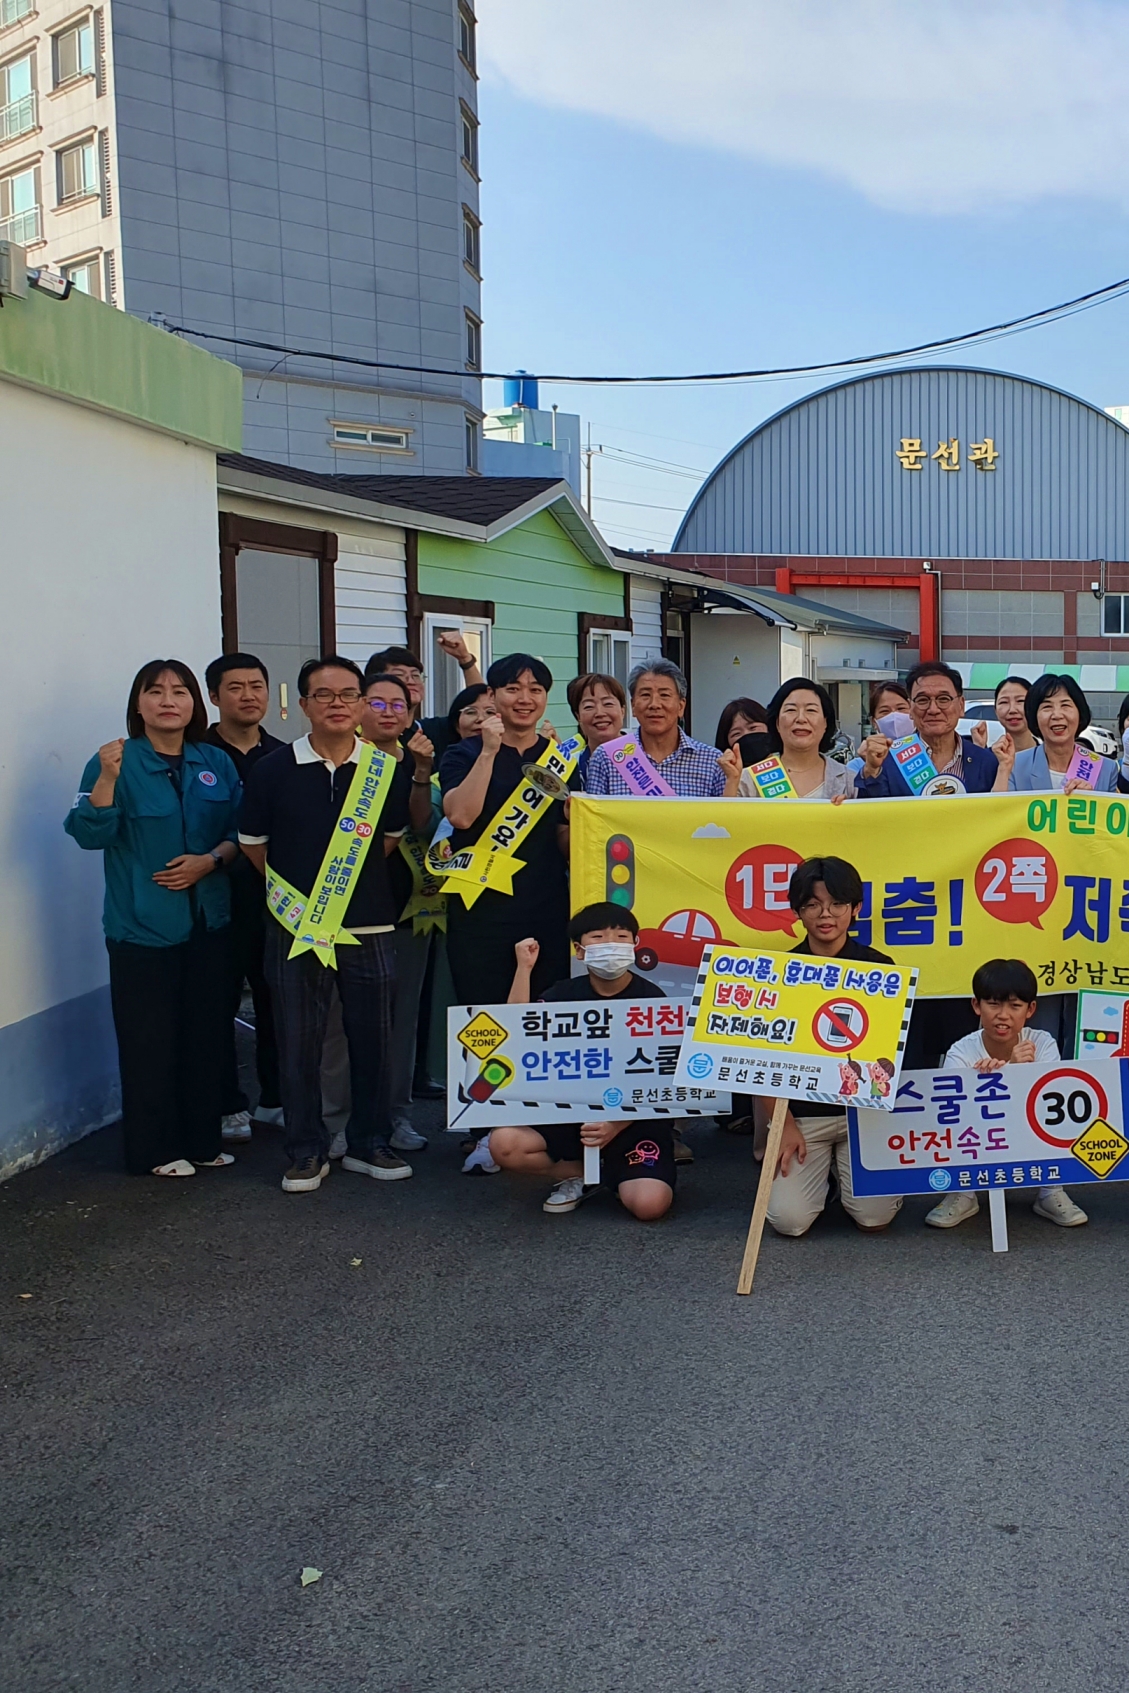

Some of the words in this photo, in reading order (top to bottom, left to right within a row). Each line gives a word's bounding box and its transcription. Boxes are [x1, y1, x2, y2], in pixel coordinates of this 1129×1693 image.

[895, 437, 999, 470] 문선관
[354, 777, 381, 819] 안전속도
[340, 820, 355, 831] 50
[357, 824, 371, 836] 30
[325, 856, 344, 885] 사람이
[334, 865, 351, 896] 줄이면
[309, 885, 332, 925] 보입니다
[851, 876, 964, 947] 춤!
[982, 857, 1048, 903] 2쪽
[713, 956, 778, 983] 이어폰,
[784, 960, 841, 989] 휴대폰
[845, 969, 901, 995] 사용은
[716, 983, 753, 1008] 보행
[757, 988, 778, 1009] 시
[465, 1027, 502, 1039] SCHOOL
[521, 1008, 614, 1042] 학교앞
[625, 1004, 690, 1038] 천천
[708, 1013, 797, 1044] 자제해요!
[471, 1038, 497, 1048] ZONE
[521, 1047, 614, 1082] 안전한
[624, 1045, 682, 1077] 스쿨
[718, 1066, 819, 1091] 문선초등학교
[631, 1087, 717, 1104] 문선초등학교
[889, 1072, 1012, 1125] 스쿨존
[1041, 1089, 1093, 1126] 30
[887, 1125, 1010, 1165] 안전속도
[1079, 1138, 1123, 1151] SCHOOL
[1087, 1150, 1118, 1162] ZONE
[958, 1165, 1062, 1187] 문선초등학교
